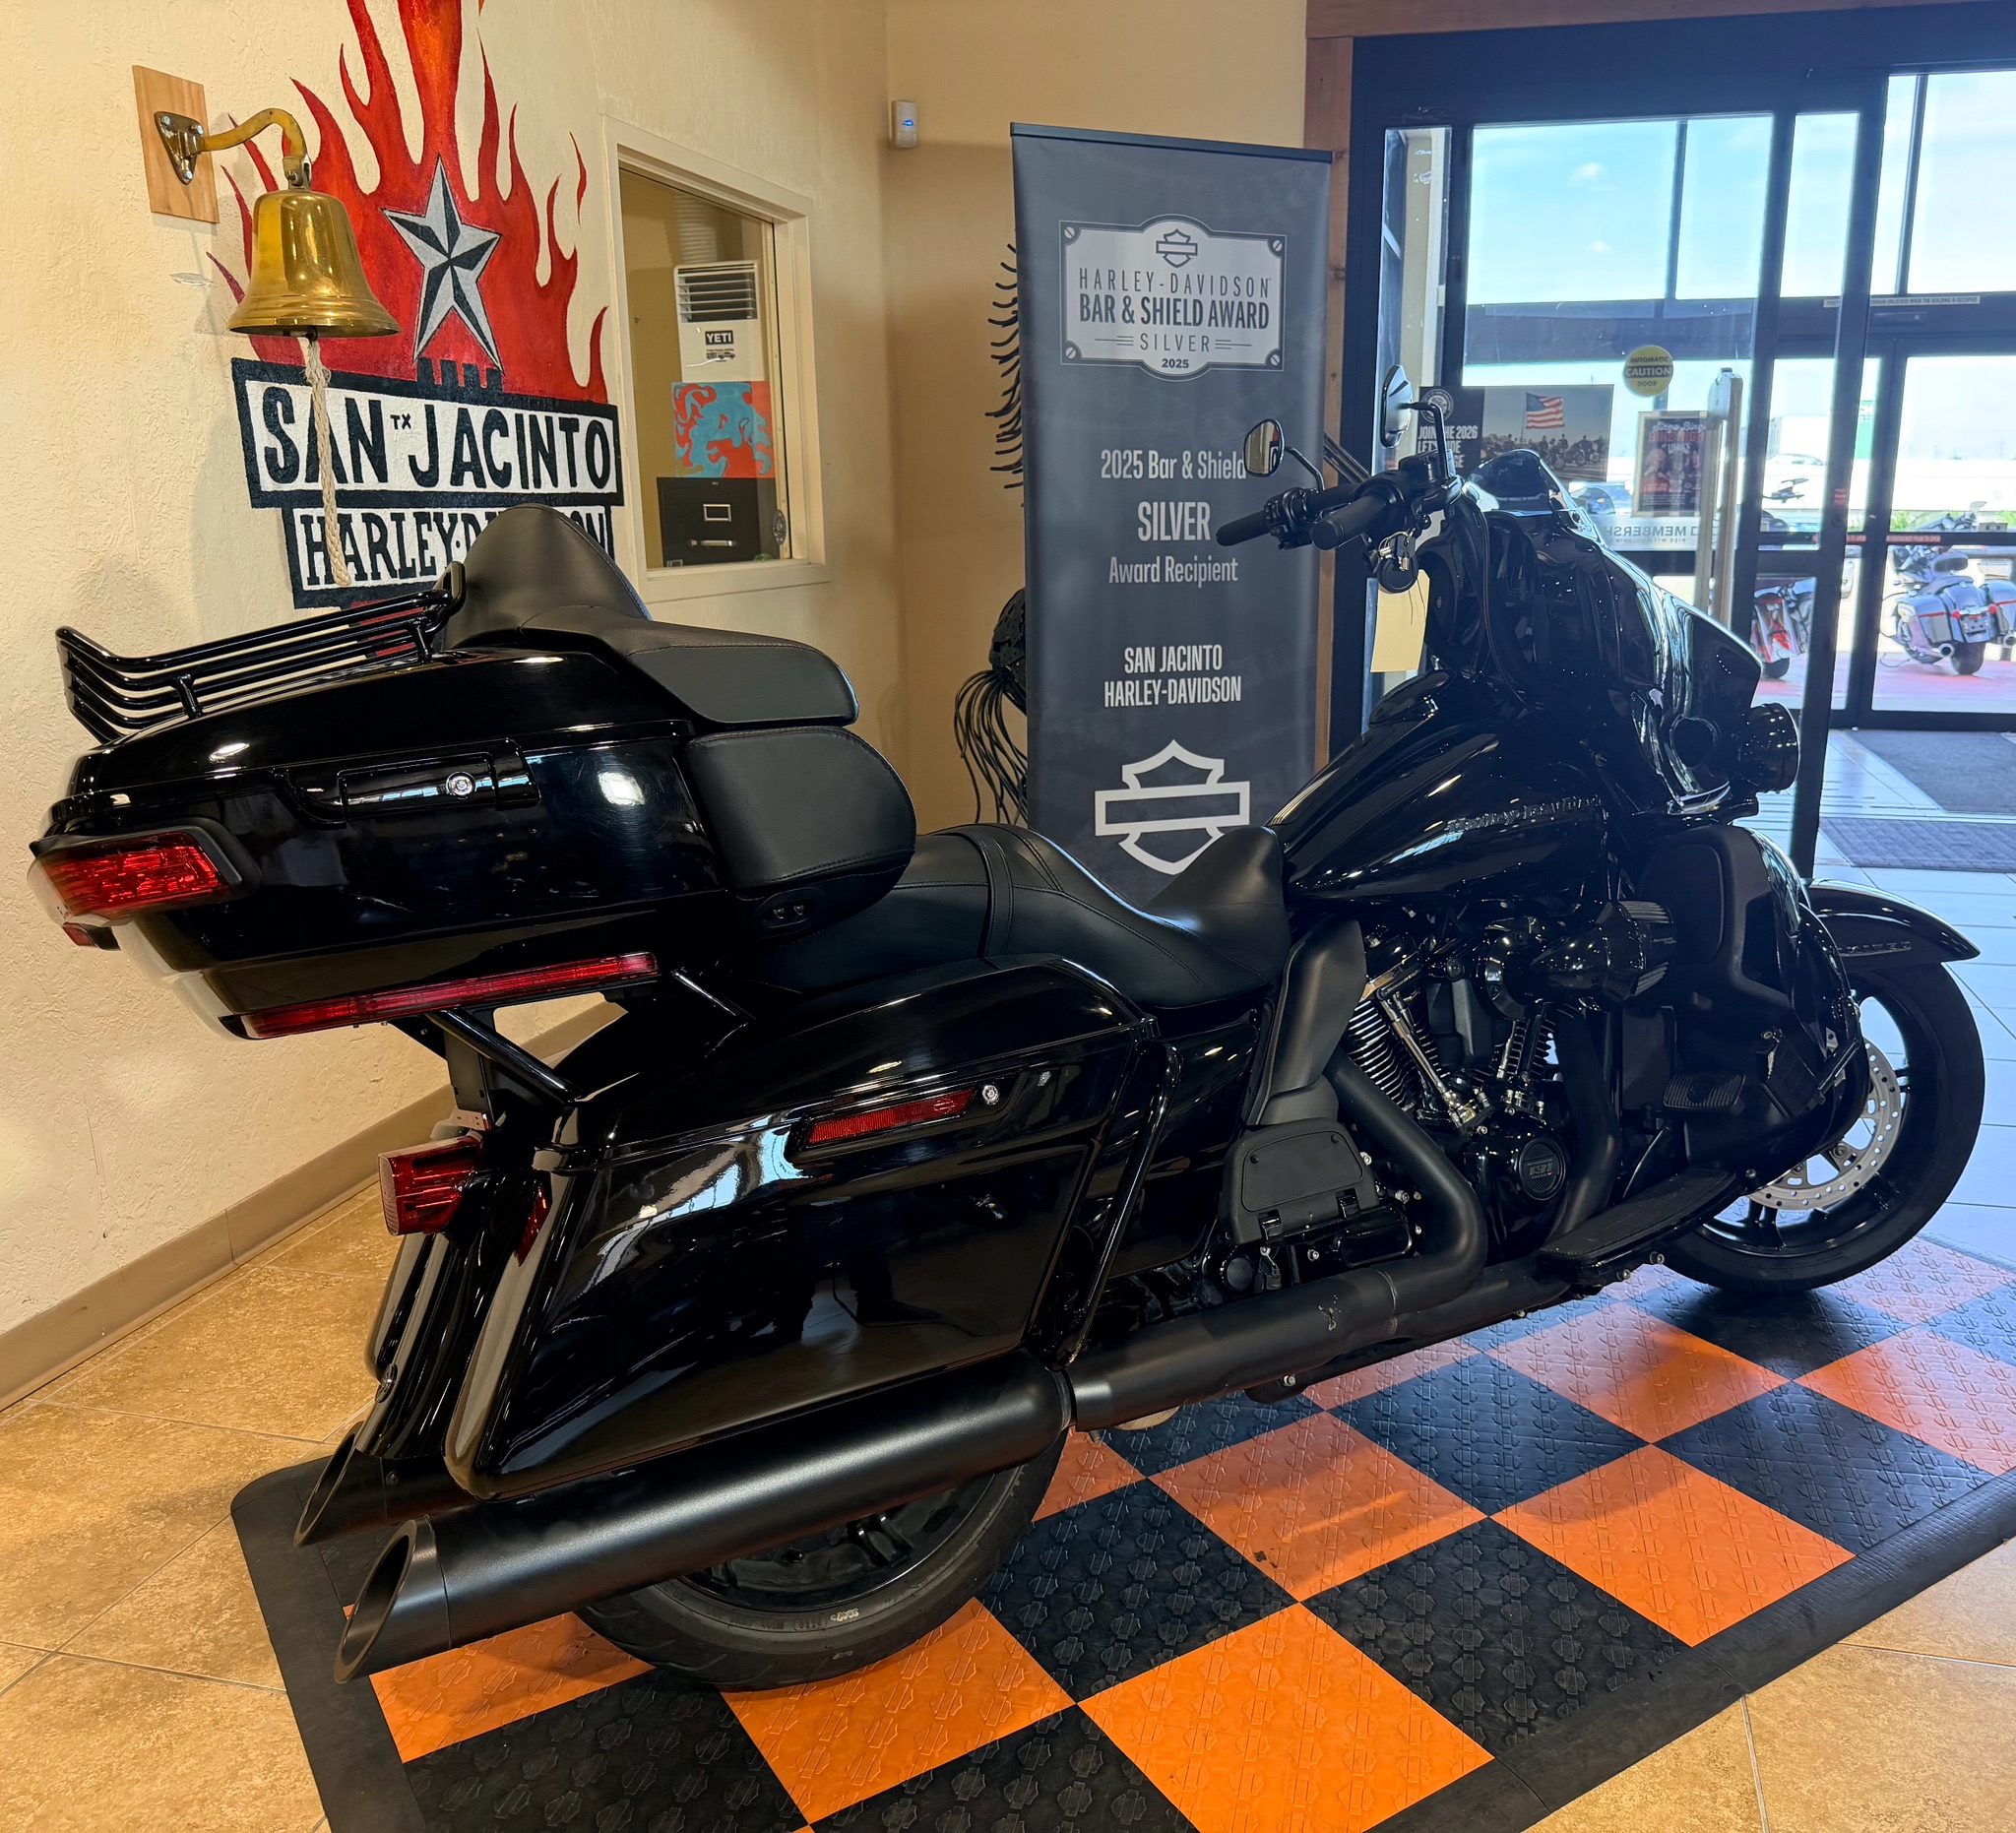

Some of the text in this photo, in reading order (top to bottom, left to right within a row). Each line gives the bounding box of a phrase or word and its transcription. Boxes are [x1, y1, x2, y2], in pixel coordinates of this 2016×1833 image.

[1080, 268, 1269, 298] HARLEY-DAVIDSON
[1080, 293, 1269, 329] BAR & SHIELD AWARD
[706, 332, 732, 344] YETI
[1140, 333, 1210, 351] SILVER
[1162, 358, 1189, 368] 2025
[1626, 367, 1671, 377] CAUTION
[262, 386, 611, 490] SAN TX JACINTO
[1456, 425, 1479, 440] 2026
[1677, 430, 1704, 442] NIGH
[1101, 449, 1246, 479] 2025 Bar & Shield
[1138, 501, 1211, 541] SILVER
[1109, 555, 1238, 588] Award Recipient
[1124, 644, 1223, 673] SAN JACINTO
[1104, 676, 1241, 707] HARLEY-DAVIDSON
